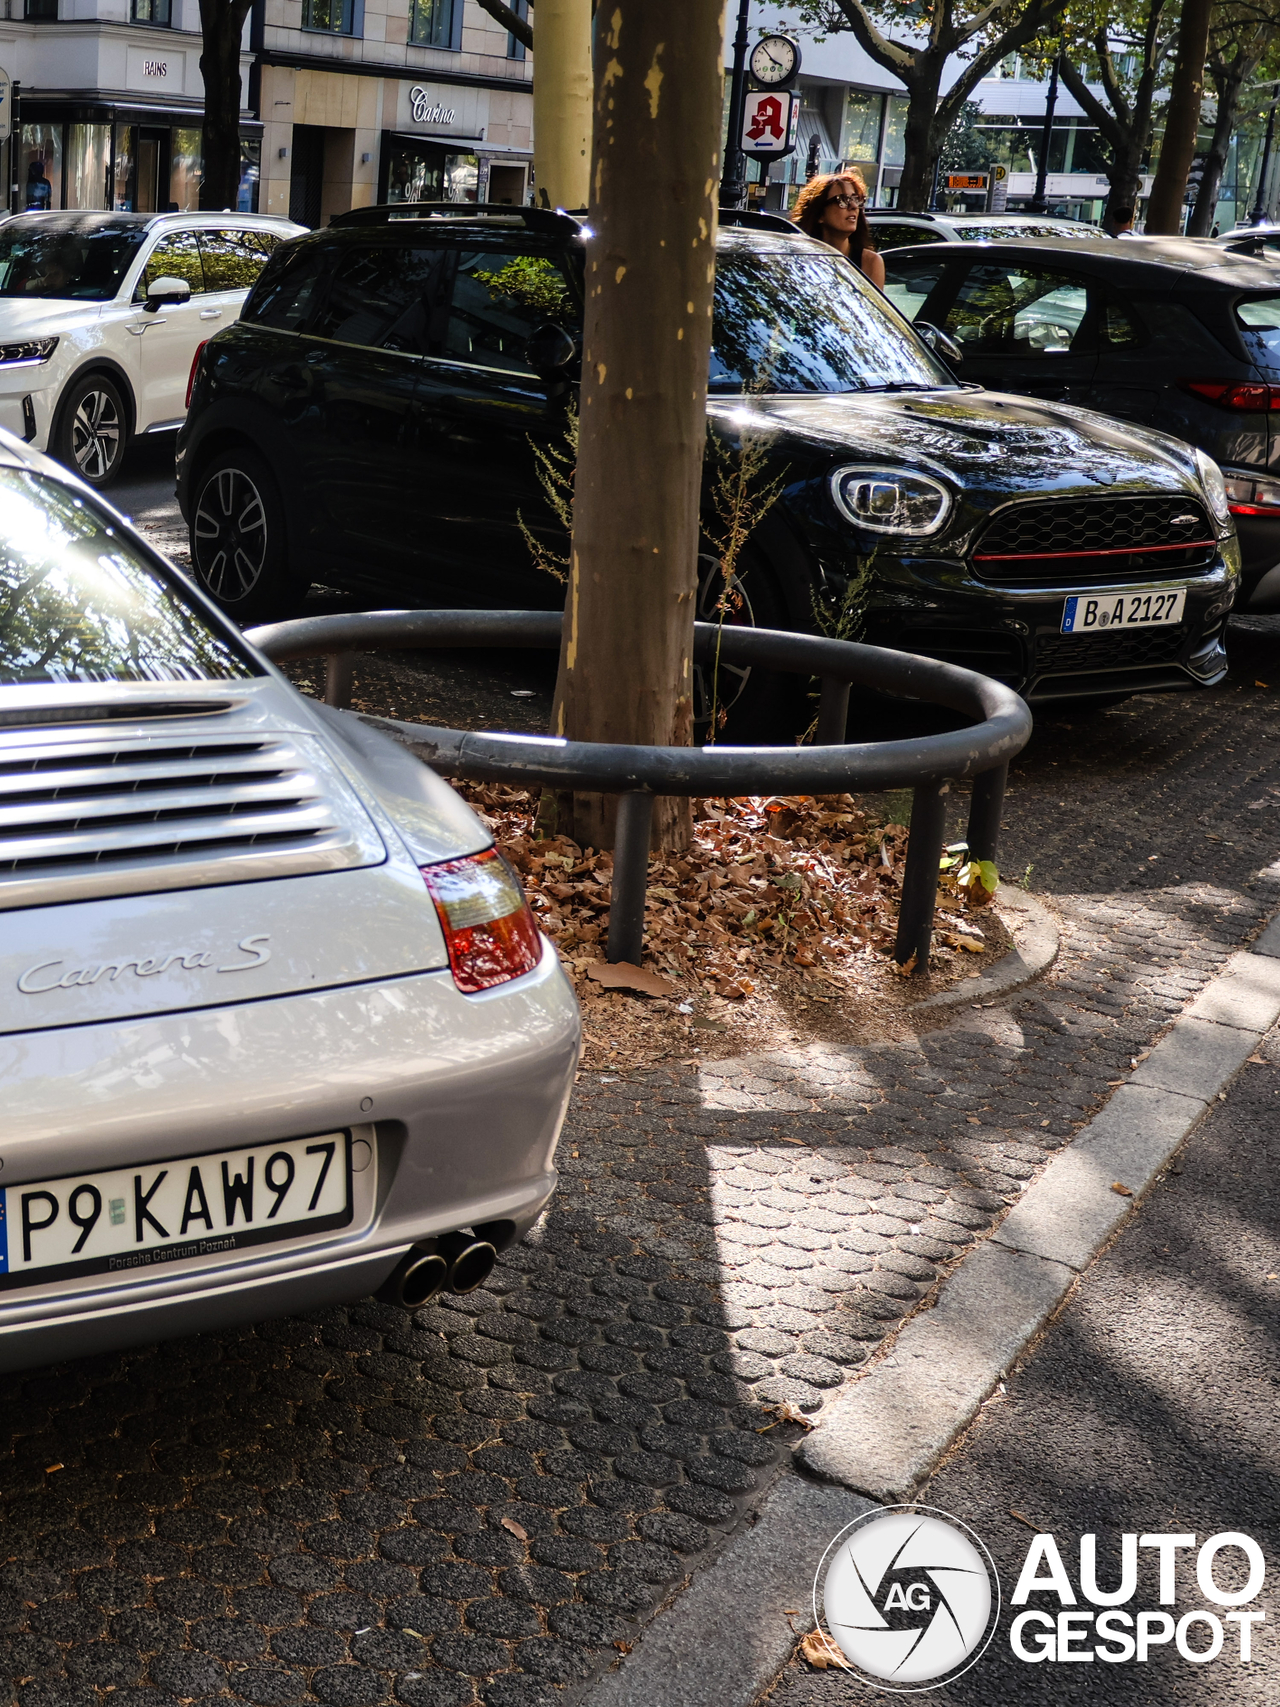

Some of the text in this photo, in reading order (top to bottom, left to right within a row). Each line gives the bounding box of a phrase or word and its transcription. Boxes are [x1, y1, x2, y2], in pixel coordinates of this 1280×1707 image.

[143, 60, 167, 77] RAINS
[410, 86, 456, 123] Carina
[1065, 618, 1072, 627] D
[1083, 600, 1098, 627] B
[17, 933, 271, 994] Carrera S
[21, 1183, 102, 1262] P9
[134, 1141, 336, 1243] KAW97
[109, 1236, 236, 1270] Porsche Centrum Poznań
